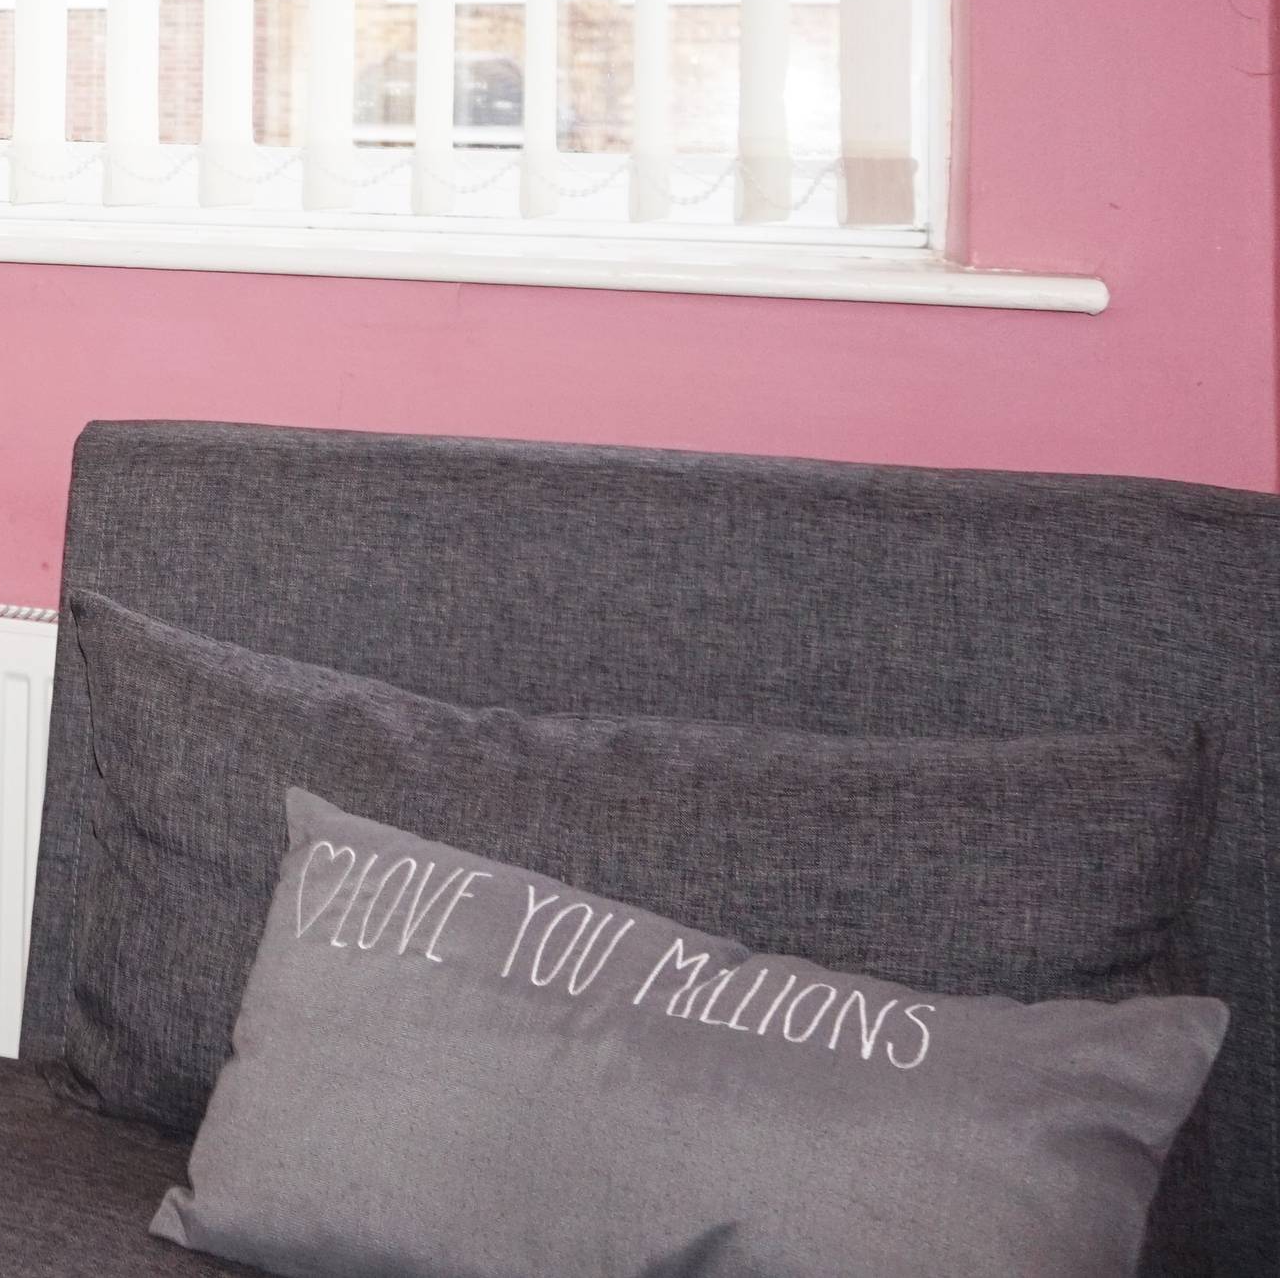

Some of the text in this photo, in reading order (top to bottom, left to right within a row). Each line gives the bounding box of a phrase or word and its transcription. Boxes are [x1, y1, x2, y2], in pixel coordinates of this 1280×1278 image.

[330, 854, 937, 1070] LOVE YOU MILLIONS
